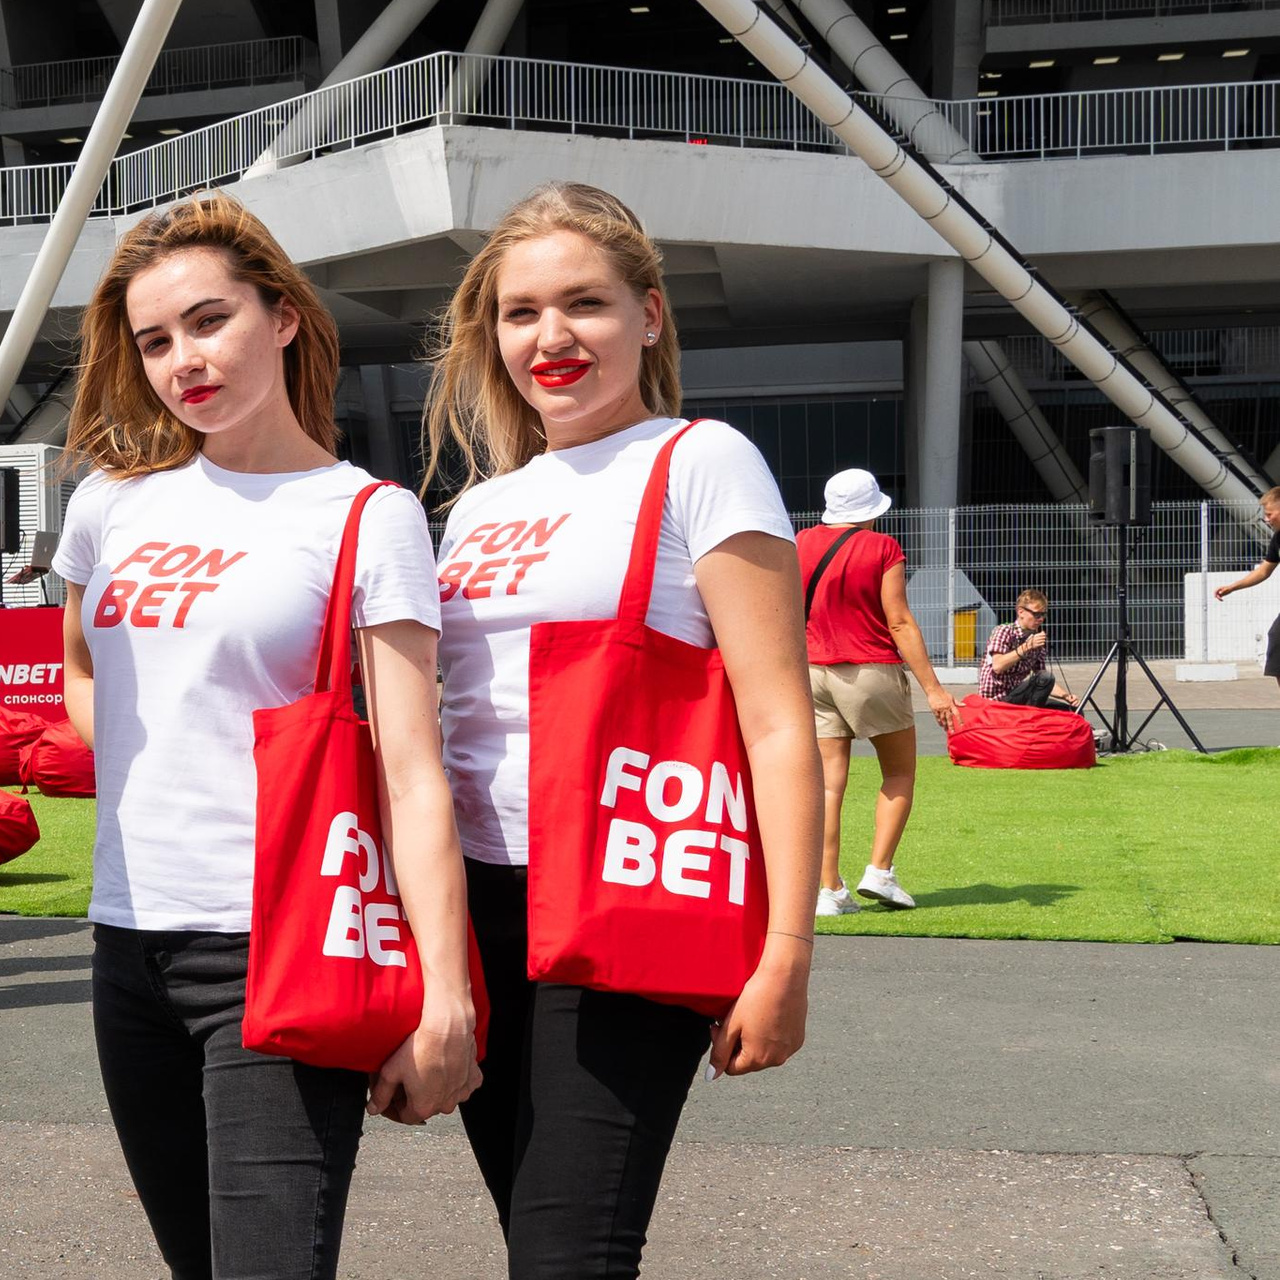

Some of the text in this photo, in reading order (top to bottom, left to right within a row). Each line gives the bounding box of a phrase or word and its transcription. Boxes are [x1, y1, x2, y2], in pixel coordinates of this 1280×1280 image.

[111, 542, 247, 578] FON
[448, 513, 572, 559] FON
[437, 551, 550, 603] BET
[94, 580, 219, 629] BET
[4, 694, 63, 705] спонсор
[599, 746, 748, 833] FON
[602, 819, 751, 906] BET
[322, 885, 409, 968] BE
